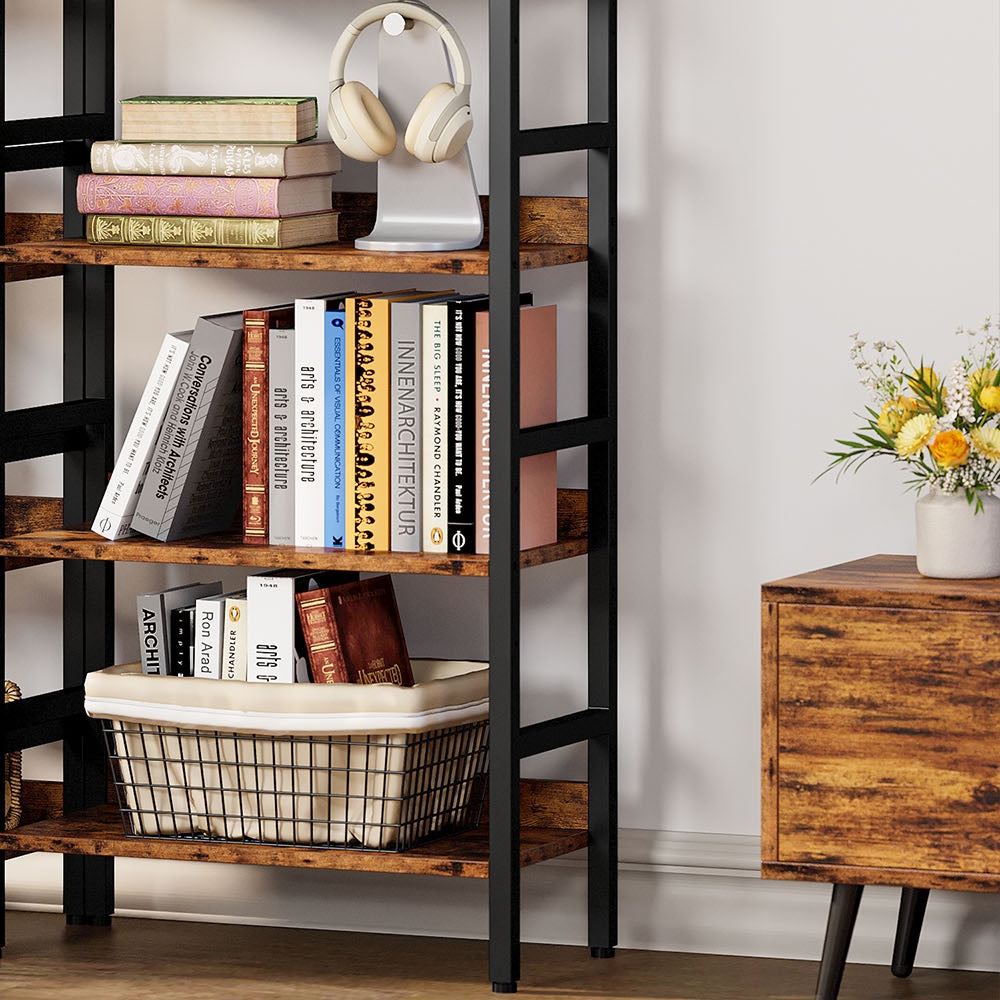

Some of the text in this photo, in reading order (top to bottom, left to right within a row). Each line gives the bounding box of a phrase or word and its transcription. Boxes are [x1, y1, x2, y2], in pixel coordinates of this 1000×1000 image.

[186, 351, 200, 372] John
[170, 403, 181, 422] and
[249, 383, 261, 439] UNEXPECTED
[334, 384, 341, 394] OF
[155, 355, 212, 500] Conversations with Architects
[160, 421, 177, 455] Heinrich
[274, 387, 291, 490] arts & architecture
[301, 366, 319, 483] arts & architecture
[397, 341, 416, 537] INNENARCHITEKTUR
[433, 321, 441, 519] THE BIG SLEEP RAYMOND CHANDLER
[152, 455, 167, 475] Klotz
[247, 438, 261, 475] JOURNEY
[334, 424, 342, 489] COMMUNICATION
[201, 612, 214, 674] Ron Arad
[228, 630, 237, 679] CHANDLER
[256, 644, 282, 668] arts
